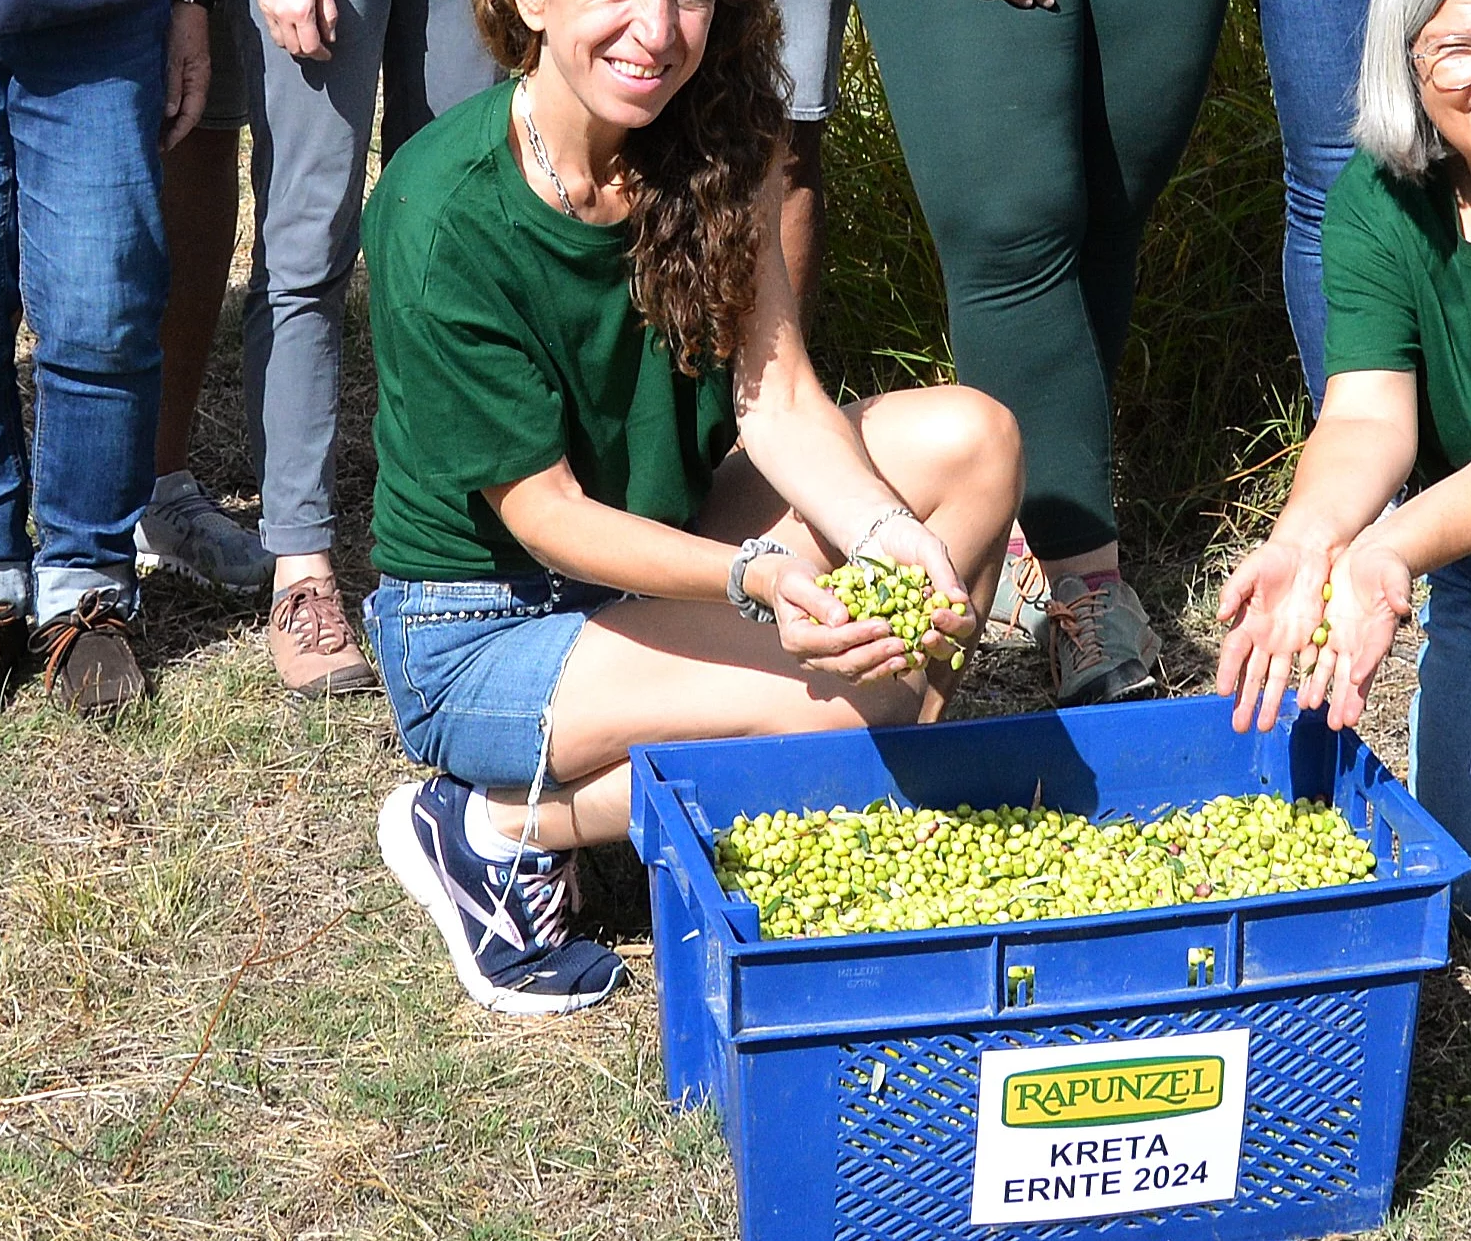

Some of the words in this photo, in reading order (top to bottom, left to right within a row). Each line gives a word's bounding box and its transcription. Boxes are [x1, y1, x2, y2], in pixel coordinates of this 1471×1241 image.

[1013, 1068, 1214, 1116] RAPUNZEL
[1050, 1134, 1169, 1167] KRETA
[1003, 1170, 1121, 1203] ERNTE
[1133, 1160, 1209, 1191] 2024
